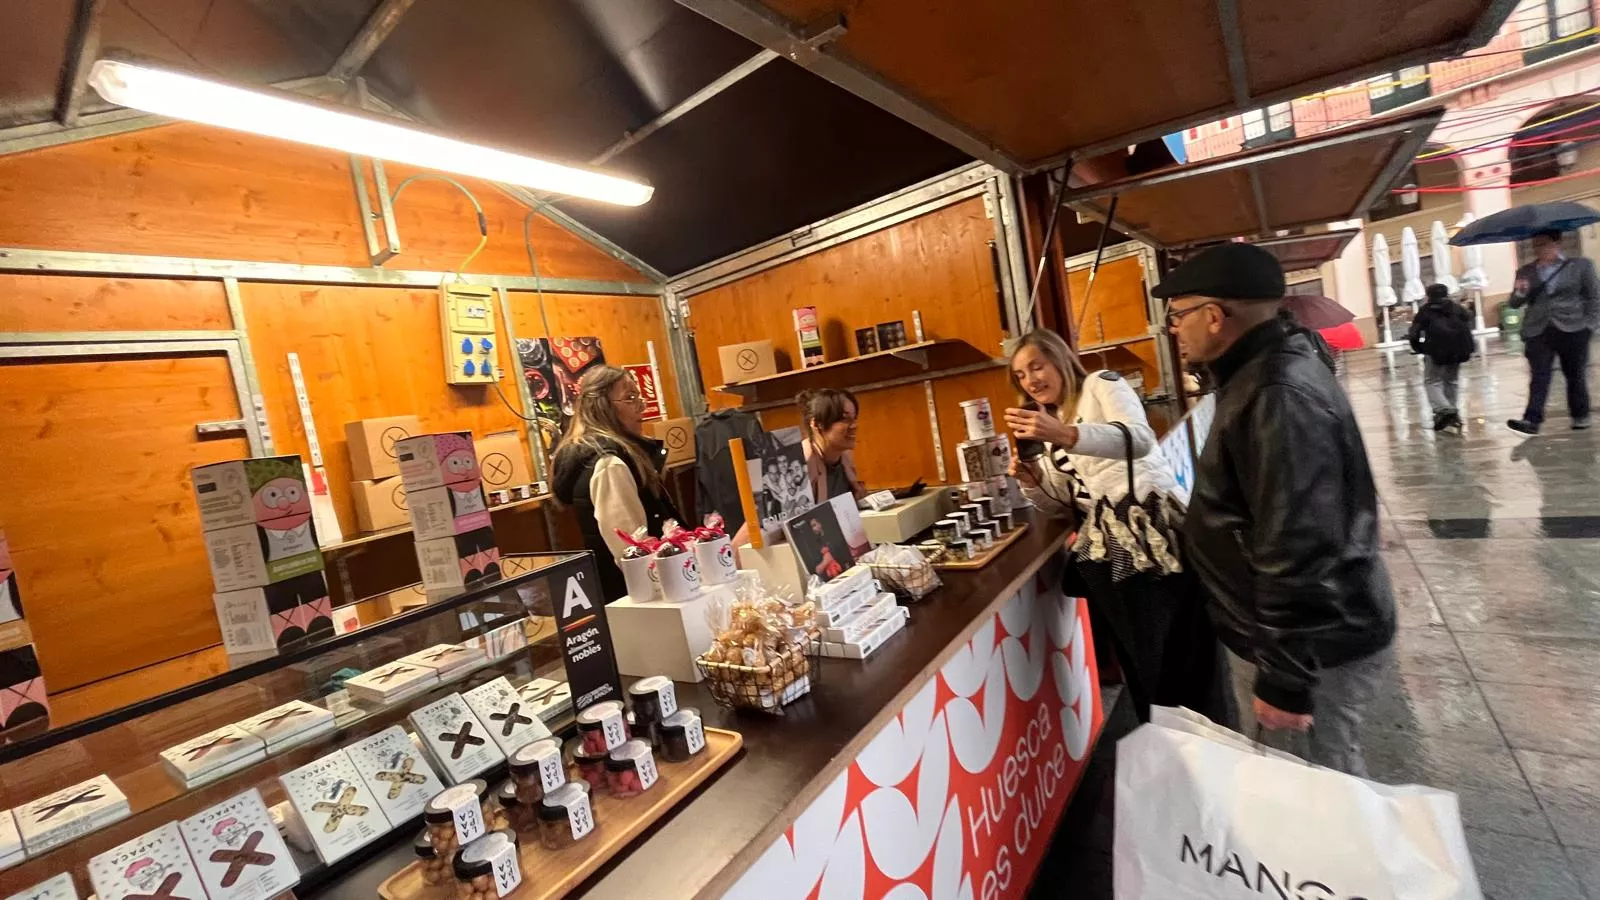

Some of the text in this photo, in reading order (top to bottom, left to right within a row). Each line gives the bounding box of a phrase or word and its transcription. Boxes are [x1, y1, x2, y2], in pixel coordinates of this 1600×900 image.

[566, 627, 600, 647] Aragón
[571, 643, 602, 663] nobles
[361, 734, 396, 751] LAPACA
[300, 761, 337, 780] LAPACA
[967, 703, 1052, 858] Huesca
[199, 801, 244, 825] LAPACA
[458, 809, 474, 822] CA
[980, 743, 1065, 900] es dulce
[460, 818, 476, 831] PA
[461, 825, 478, 839] LA
[111, 839, 162, 865] LAPACA
